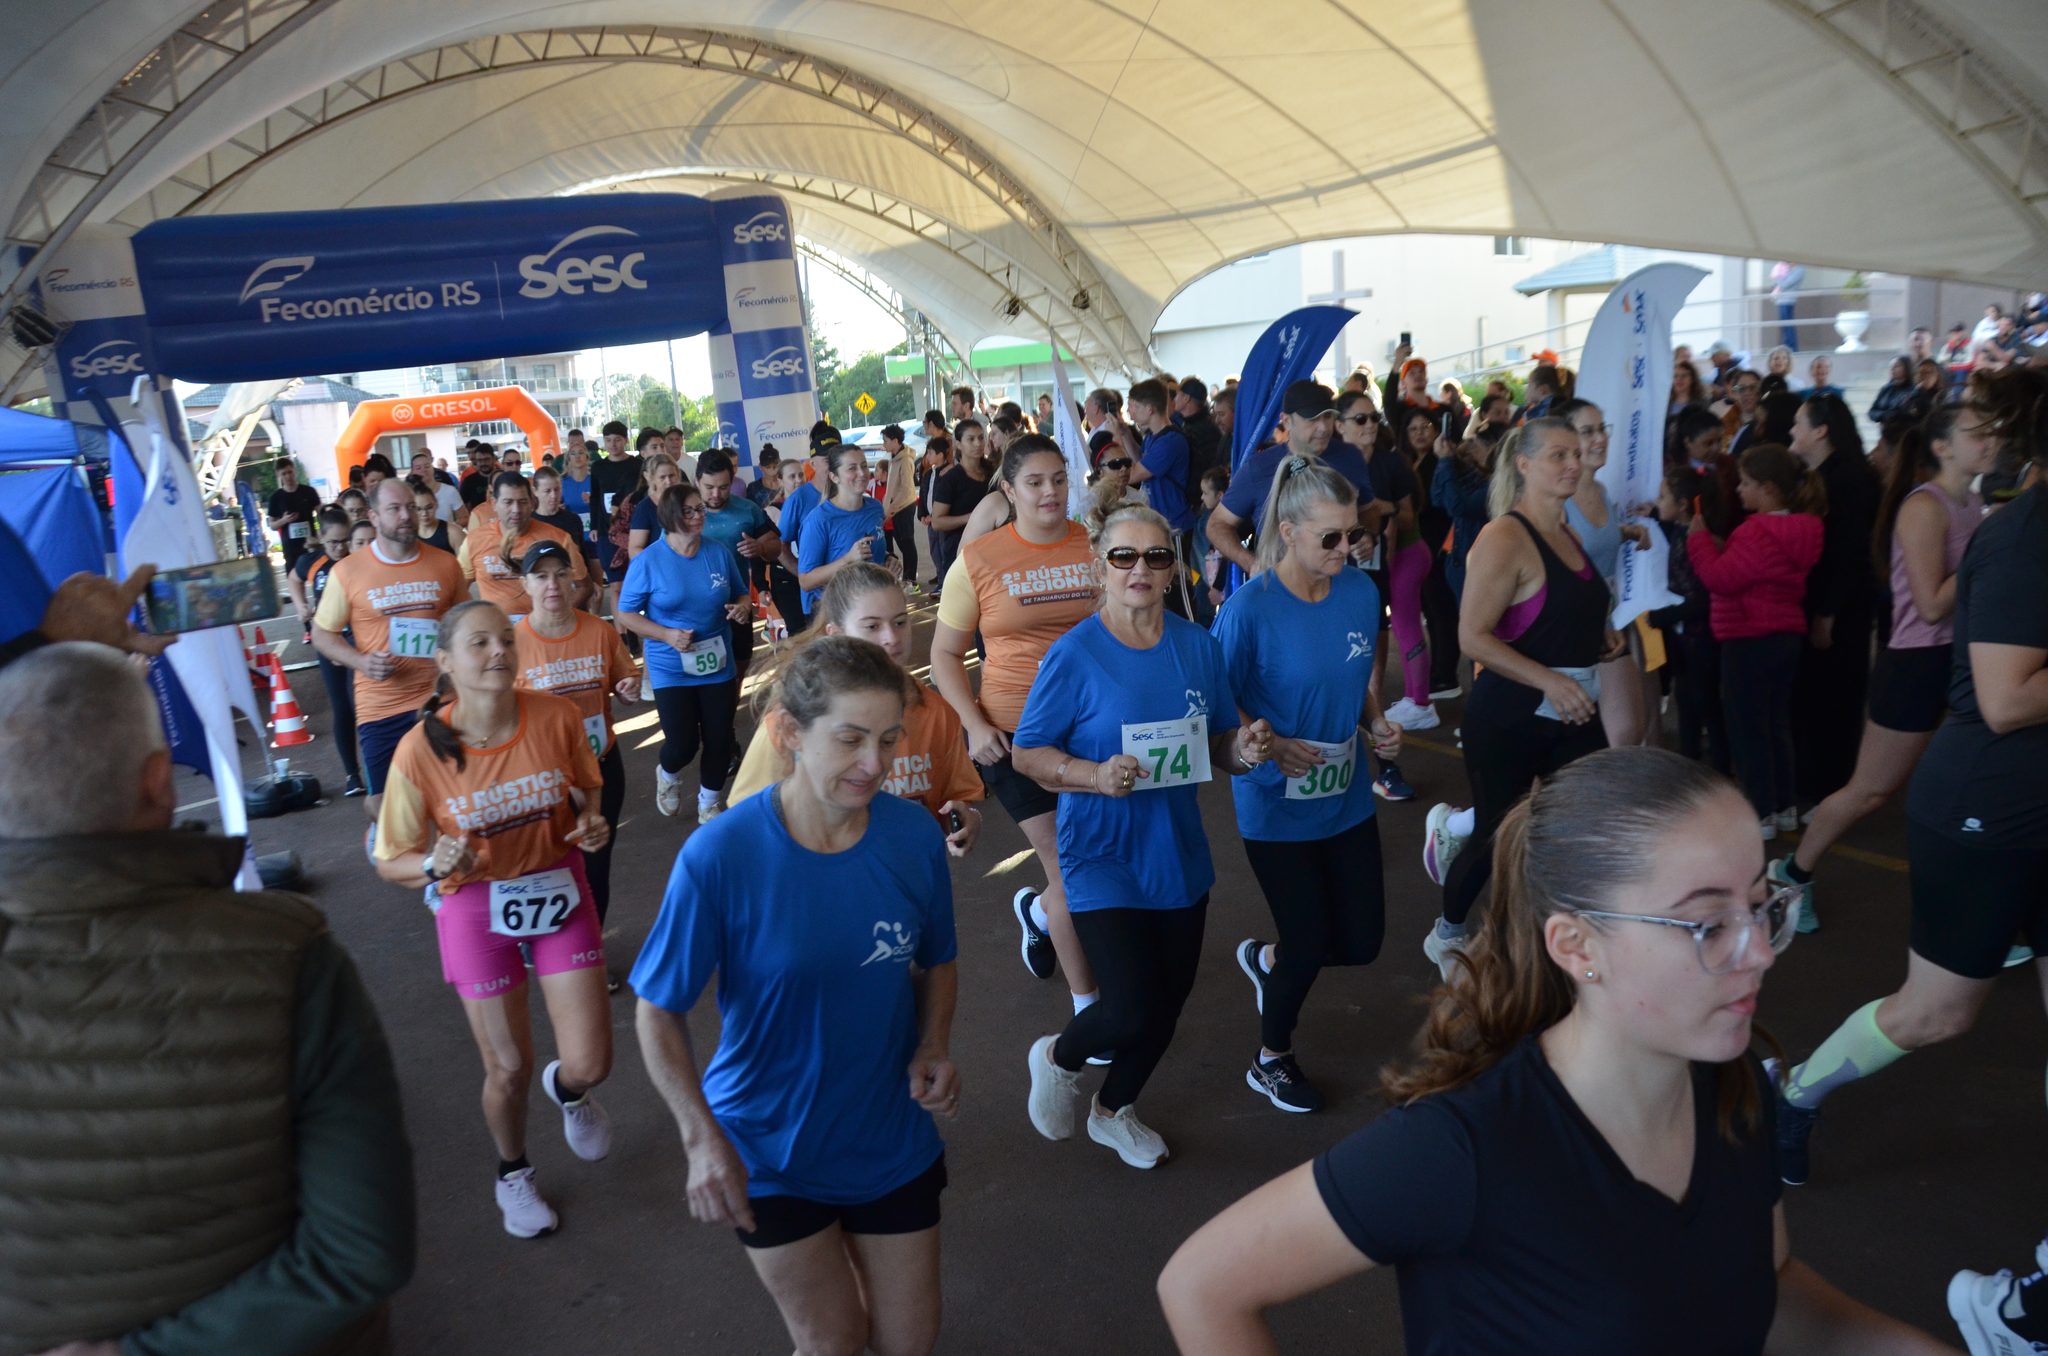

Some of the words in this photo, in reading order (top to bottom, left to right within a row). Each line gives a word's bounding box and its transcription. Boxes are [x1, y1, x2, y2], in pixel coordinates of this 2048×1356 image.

[120, 276, 135, 287] RS
[261, 286, 434, 323] Fecomércio
[441, 280, 481, 308] RS
[738, 295, 789, 308] Fecomércio
[419, 397, 497, 419] CRESOL
[759, 426, 808, 441] Fecomércio
[384, 581, 441, 596] RÚSTICA
[372, 592, 441, 609] REGIONAL
[1023, 597, 1032, 605] DE
[397, 632, 438, 656] 117
[544, 654, 603, 674] RÚSTICA
[695, 651, 718, 673] 59
[533, 666, 605, 689] REGIONAL
[892, 752, 932, 777] TICA
[1147, 743, 1191, 783] 74
[471, 767, 566, 809] RÚSTICA
[880, 771, 932, 796] ONAL
[1298, 758, 1351, 796] 300
[455, 786, 564, 830] REGIONAL
[502, 893, 570, 931] 672
[472, 975, 511, 994] RUN
